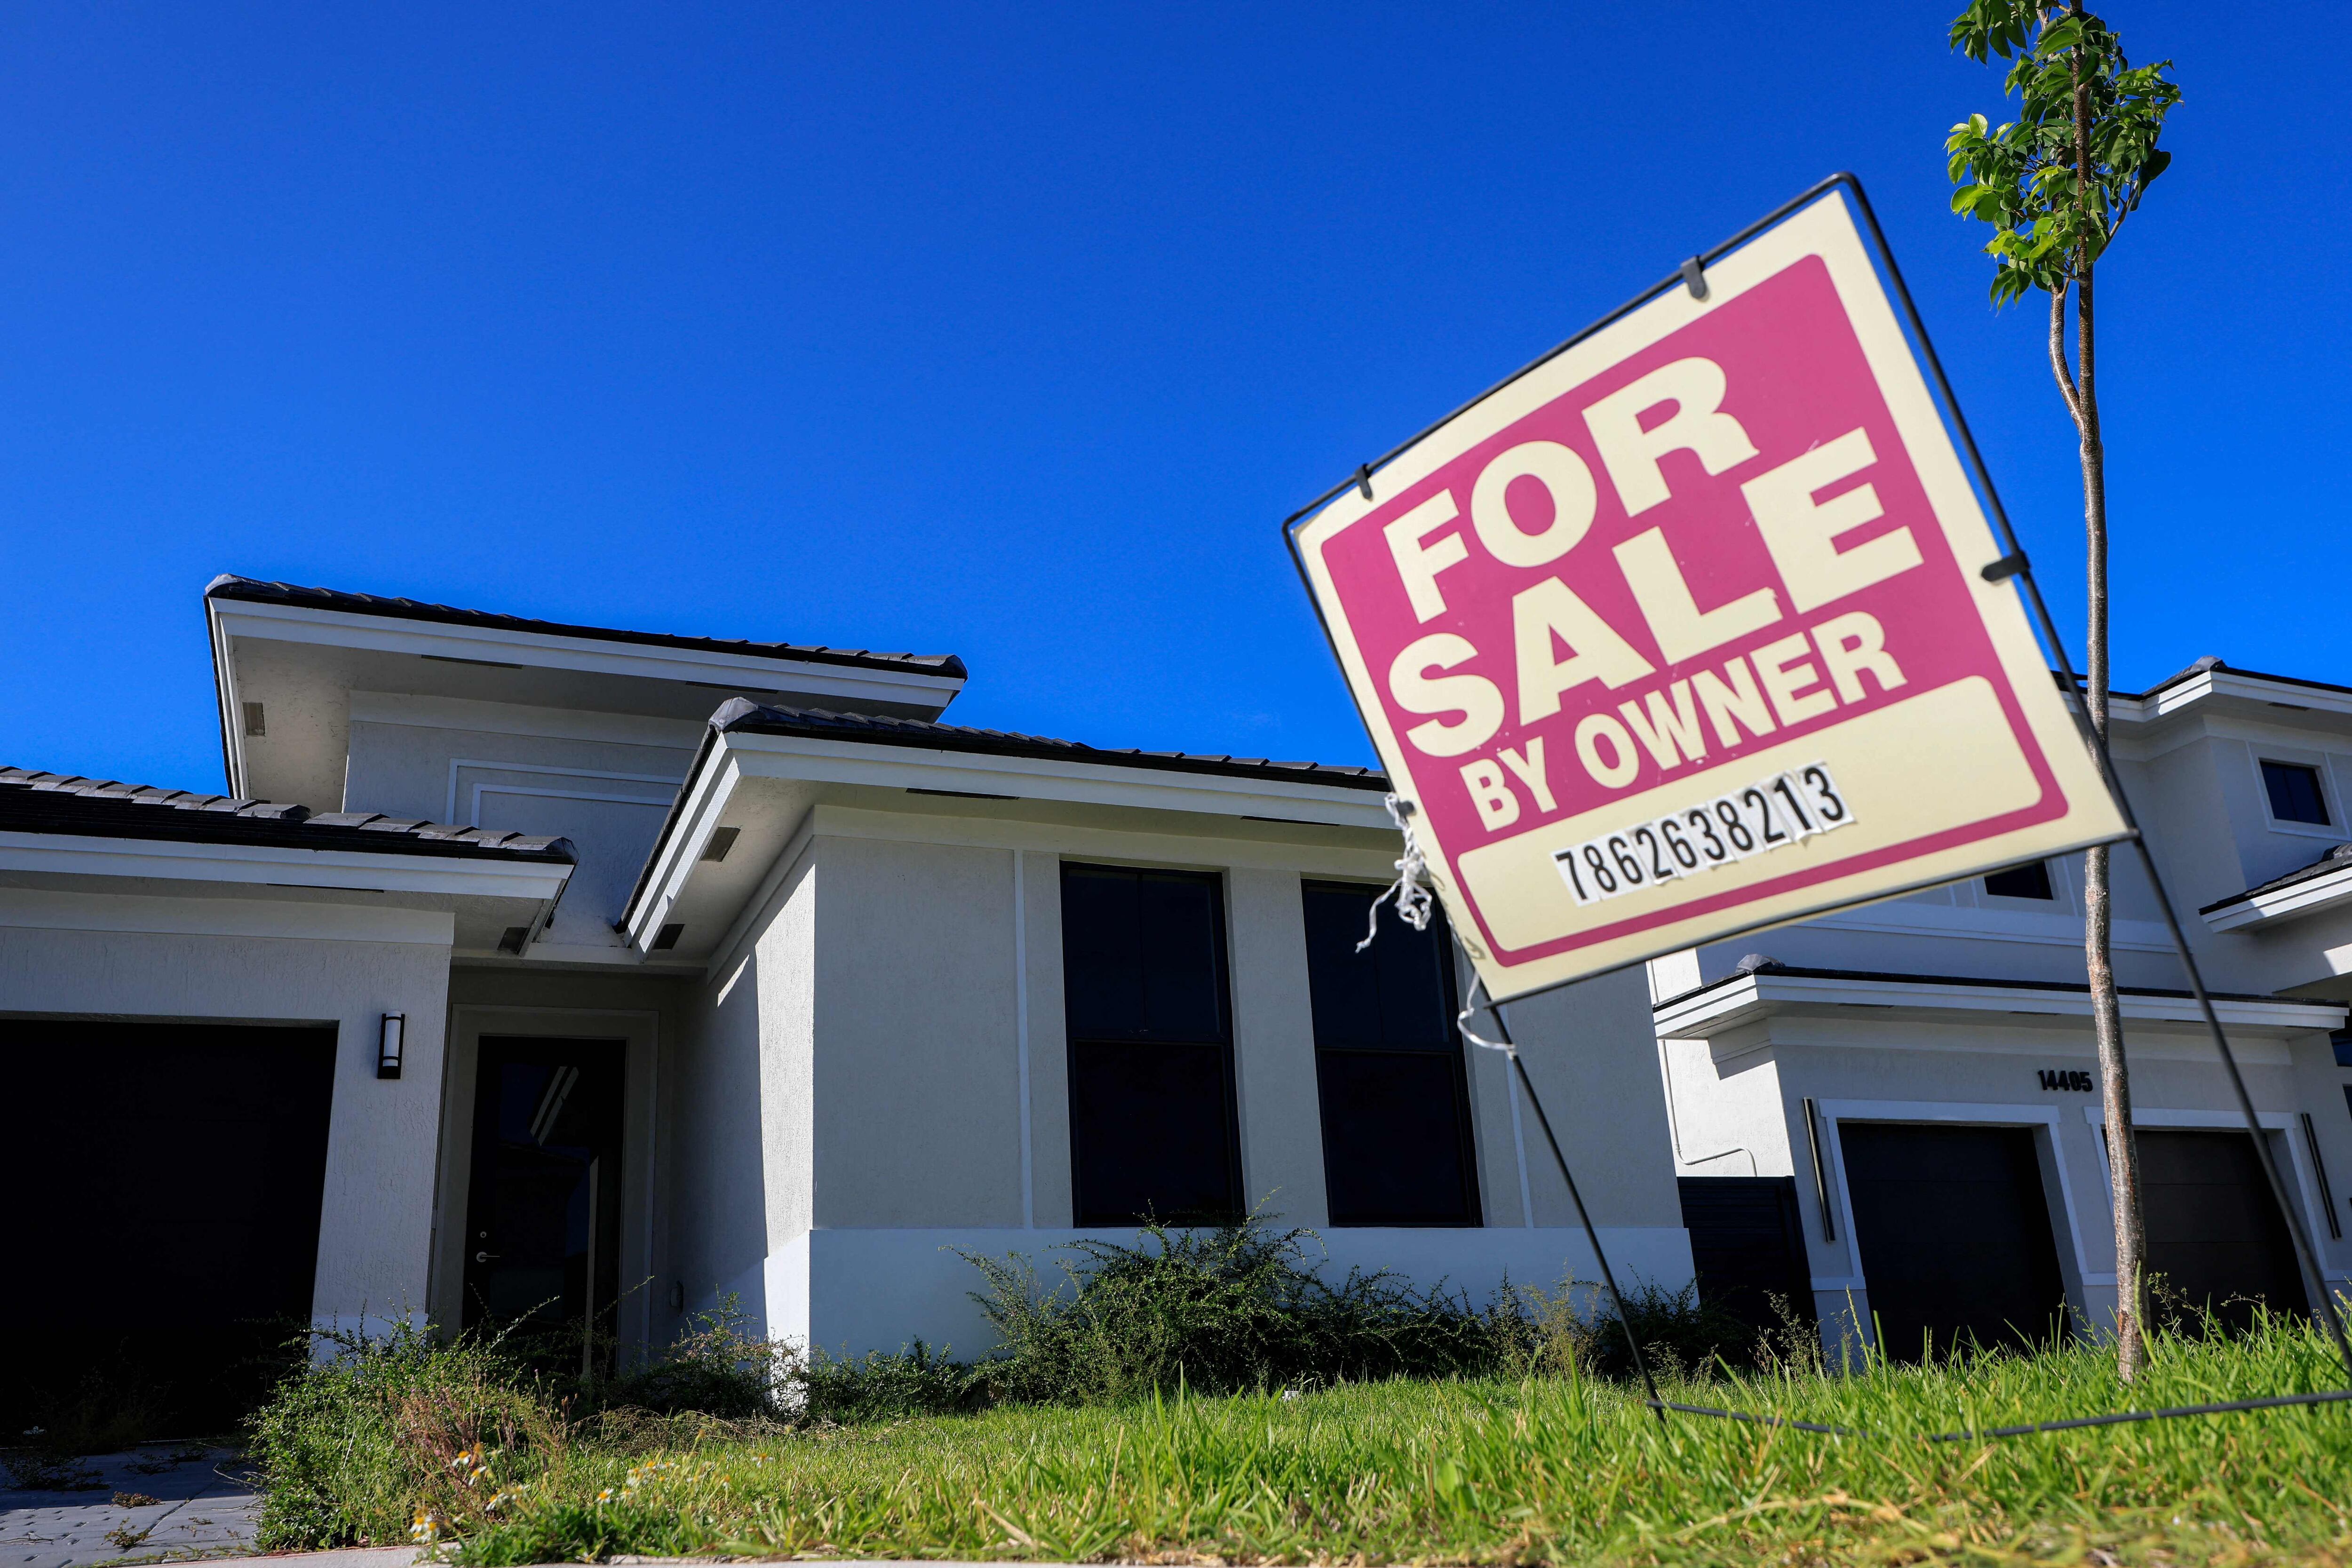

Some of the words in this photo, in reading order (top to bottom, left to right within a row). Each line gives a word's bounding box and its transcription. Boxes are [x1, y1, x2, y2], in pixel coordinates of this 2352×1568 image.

[1383, 357, 1760, 624] FOR
[1389, 426, 1924, 756] SALE
[1459, 736, 1557, 832] BY
[1574, 611, 1907, 788] OWNER
[1556, 766, 1843, 900] 7862638213
[2038, 1070, 2093, 1091] 14405
